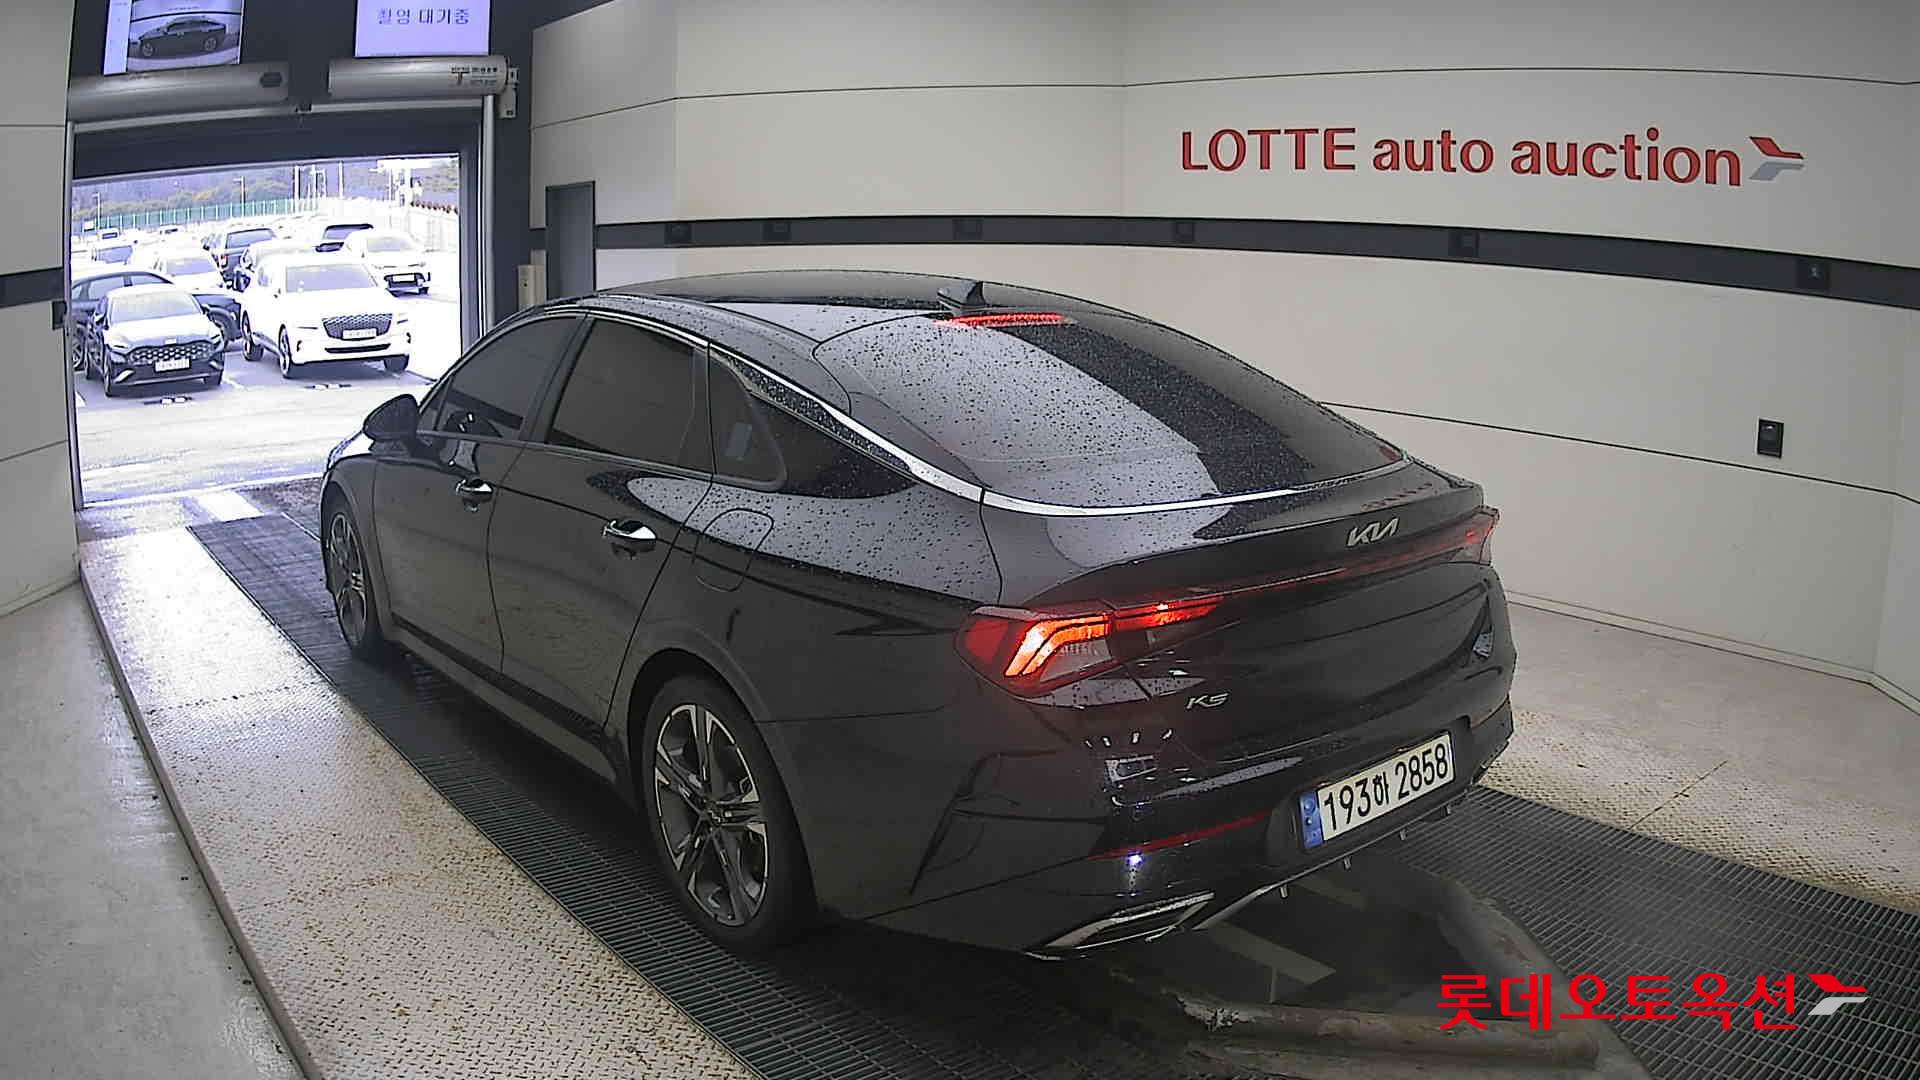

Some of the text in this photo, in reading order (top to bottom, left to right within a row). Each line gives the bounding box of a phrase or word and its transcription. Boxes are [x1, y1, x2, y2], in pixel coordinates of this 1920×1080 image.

[418, 8, 469, 24] 대기중
[1181, 127, 1741, 187] LOTTE auto auction
[1186, 692, 1229, 710] K5
[1323, 743, 1448, 831] 193하 2858
